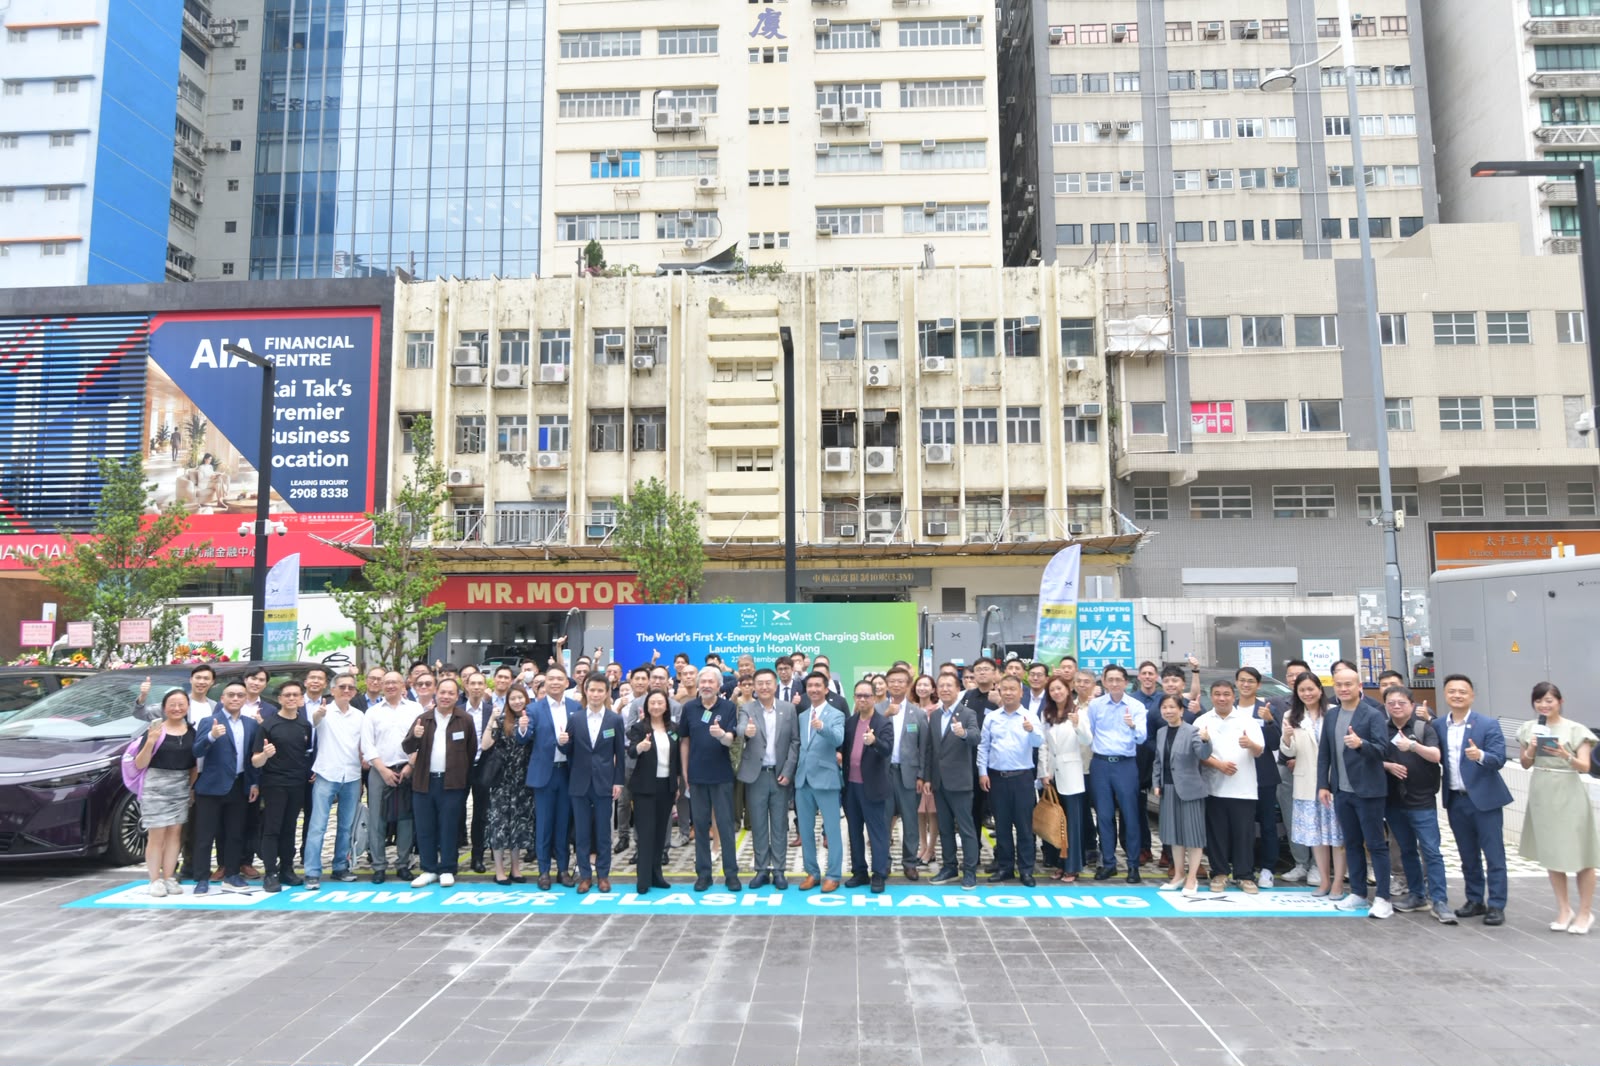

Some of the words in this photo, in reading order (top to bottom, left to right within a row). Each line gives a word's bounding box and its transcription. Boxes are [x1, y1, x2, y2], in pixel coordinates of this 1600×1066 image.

[265, 336, 354, 350] FINANCIAL
[190, 338, 257, 369] AIA
[264, 353, 332, 367] CENTRE
[273, 402, 344, 421] remier
[272, 425, 351, 444] usiness
[271, 449, 349, 468] ocation
[289, 488, 318, 499] 2908
[320, 487, 349, 498] 8338
[636, 632, 655, 642] The
[692, 631, 715, 642] First
[715, 631, 761, 643] X-Energy
[763, 631, 812, 643] MegaWatt
[814, 631, 859, 643] Charging
[860, 631, 895, 641] Station
[709, 644, 755, 654] Launches
[756, 644, 766, 654] in
[767, 644, 793, 655] Hong
[795, 644, 820, 655] Kong
[290, 890, 433, 904] 1MW
[580, 892, 783, 906] FLASH
[807, 894, 1150, 909] CHARGING
